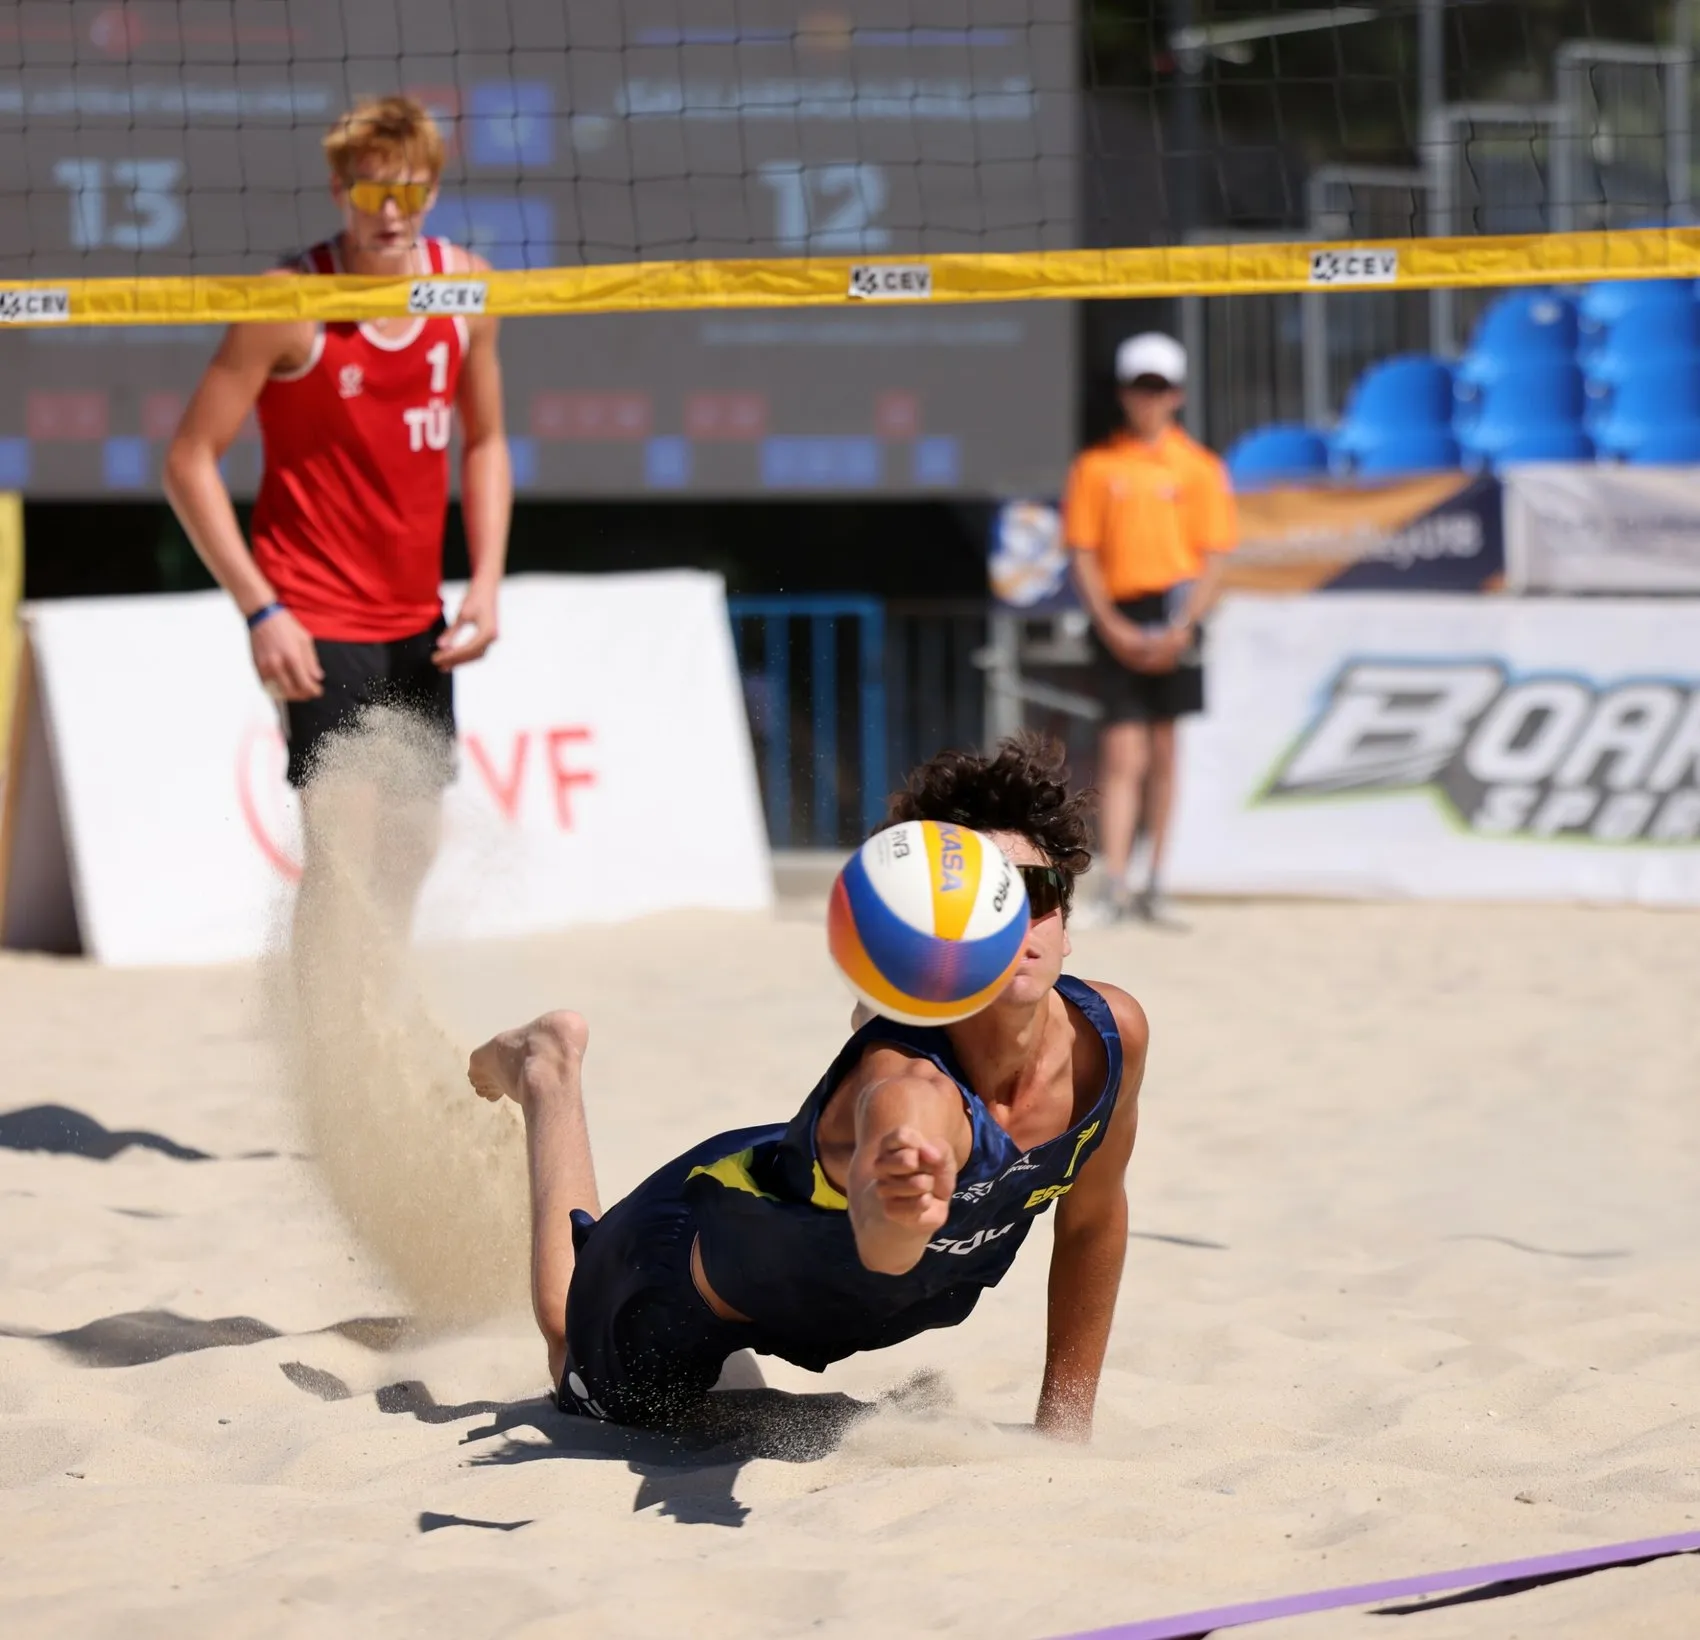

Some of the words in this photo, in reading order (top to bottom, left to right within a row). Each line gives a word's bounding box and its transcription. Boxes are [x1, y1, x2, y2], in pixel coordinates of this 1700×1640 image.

[54, 157, 185, 249] 13
[759, 161, 890, 250] 12
[884, 271, 930, 291] CEV
[1346, 256, 1395, 274] CEV
[425, 341, 449, 393] 1
[402, 398, 452, 452] TÜ
[463, 724, 598, 831] VF
